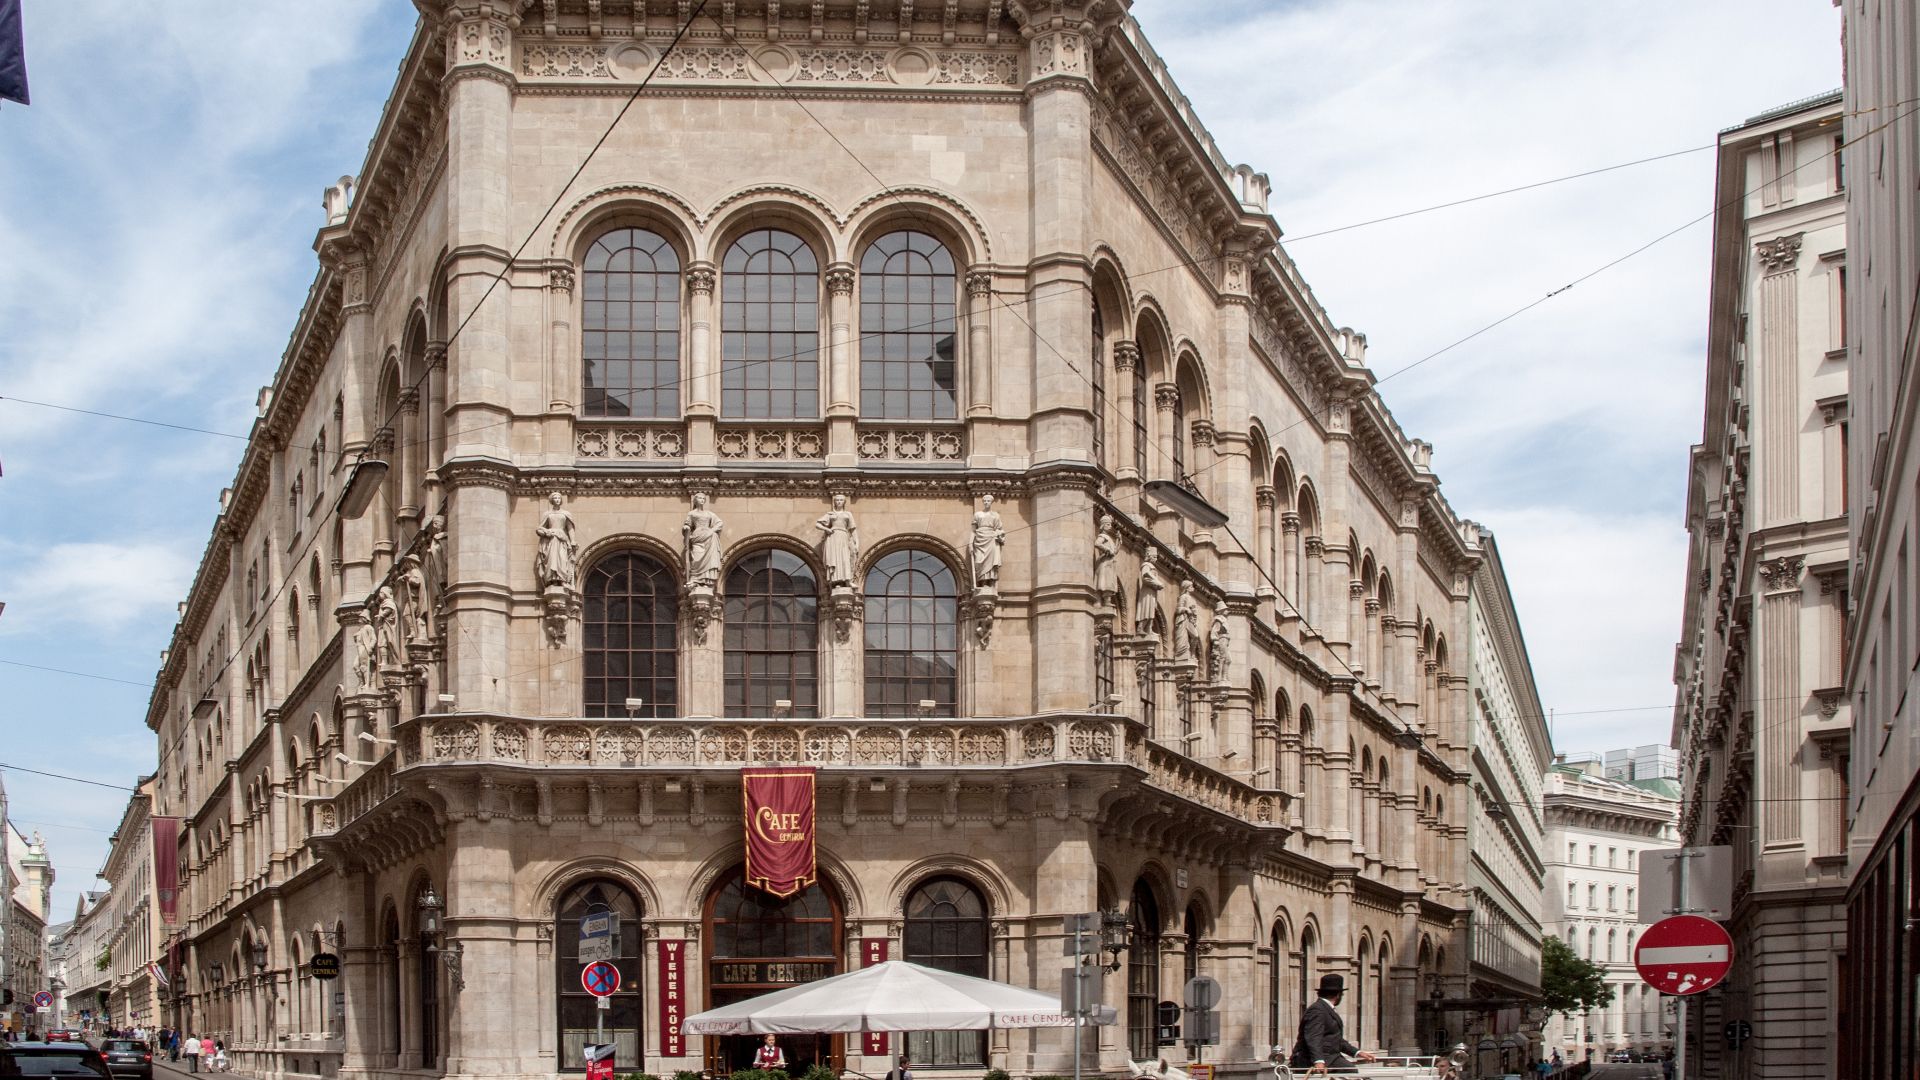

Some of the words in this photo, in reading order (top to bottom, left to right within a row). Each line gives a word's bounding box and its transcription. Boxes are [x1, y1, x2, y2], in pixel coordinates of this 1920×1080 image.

[756, 806, 800, 843] CAFE
[779, 832, 804, 842] CENTRAL
[589, 919, 607, 932] EINBAHN
[316, 958, 334, 966] CAFE
[667, 943, 678, 1000] WIENER
[723, 964, 757, 982] CAFE
[767, 963, 826, 982] CENTRAL
[1001, 1014, 1028, 1024] CAFE
[668, 1005, 678, 1054] KÜCHE
